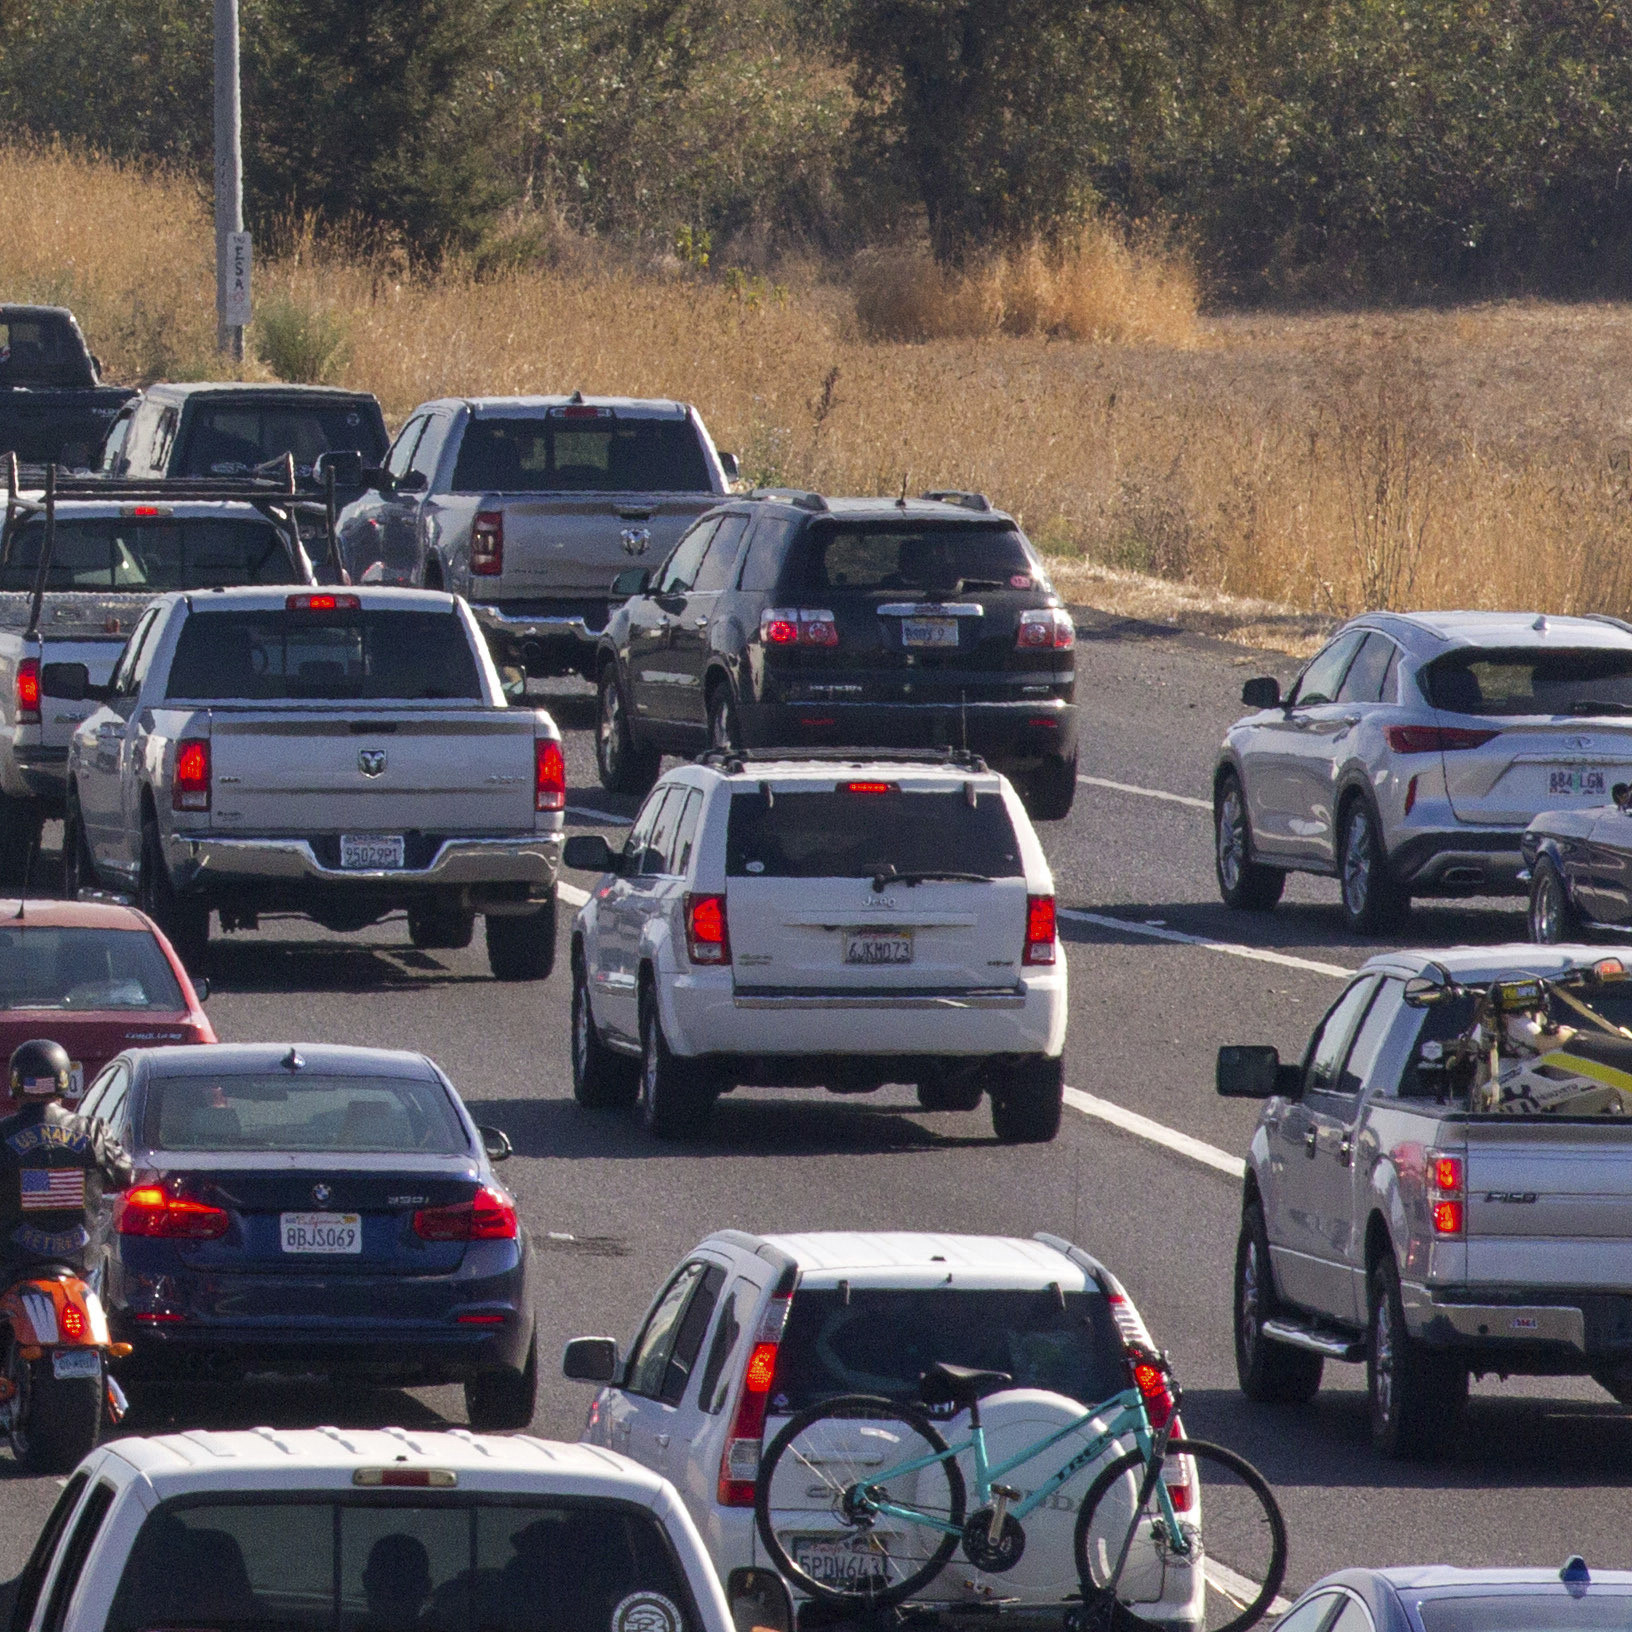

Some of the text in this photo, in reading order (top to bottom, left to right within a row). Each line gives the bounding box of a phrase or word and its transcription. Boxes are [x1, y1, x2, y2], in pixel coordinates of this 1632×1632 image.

[861, 896, 897, 908] Jeep
[15, 1125, 83, 1148] US NAVY
[287, 1228, 356, 1247] 8BJS069
